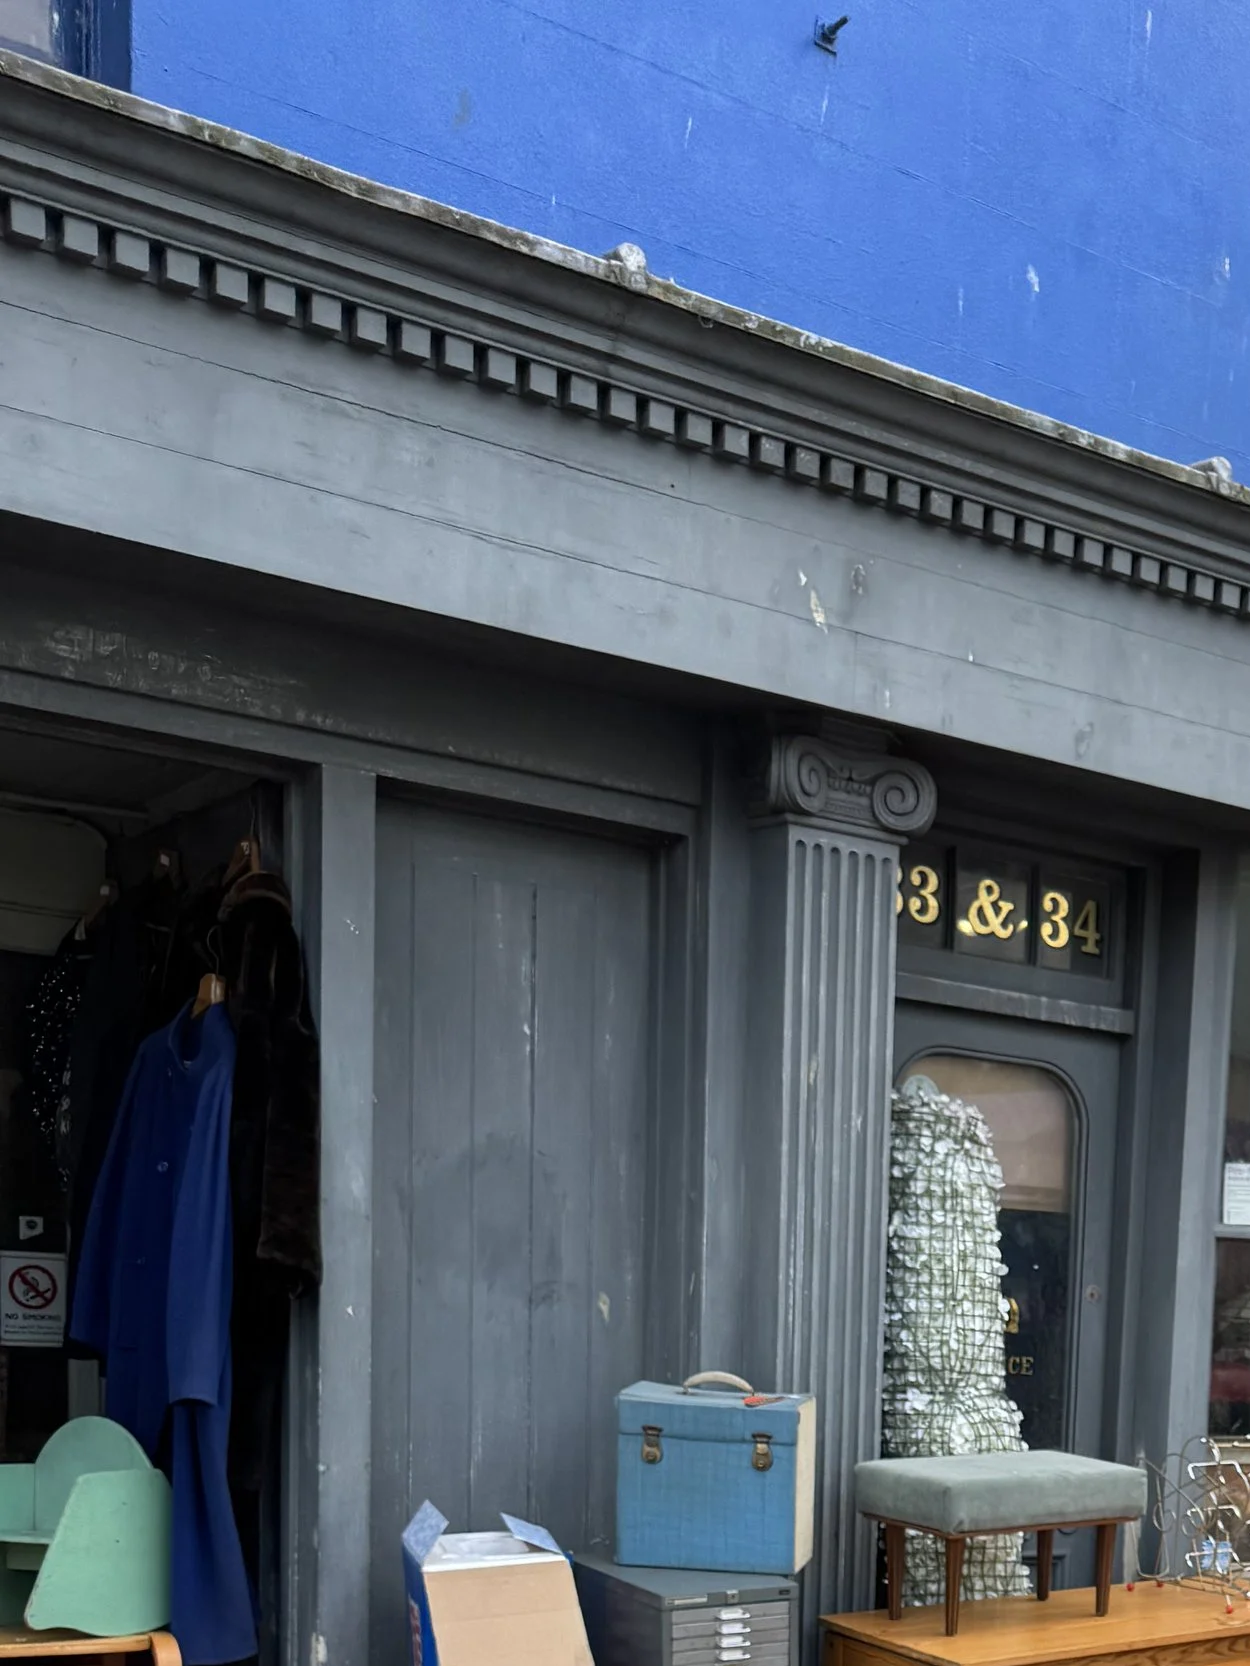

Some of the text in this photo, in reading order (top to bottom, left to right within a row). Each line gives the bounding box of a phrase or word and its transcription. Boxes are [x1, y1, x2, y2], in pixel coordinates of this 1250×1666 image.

[896, 864, 1102, 956] 3 & 34
